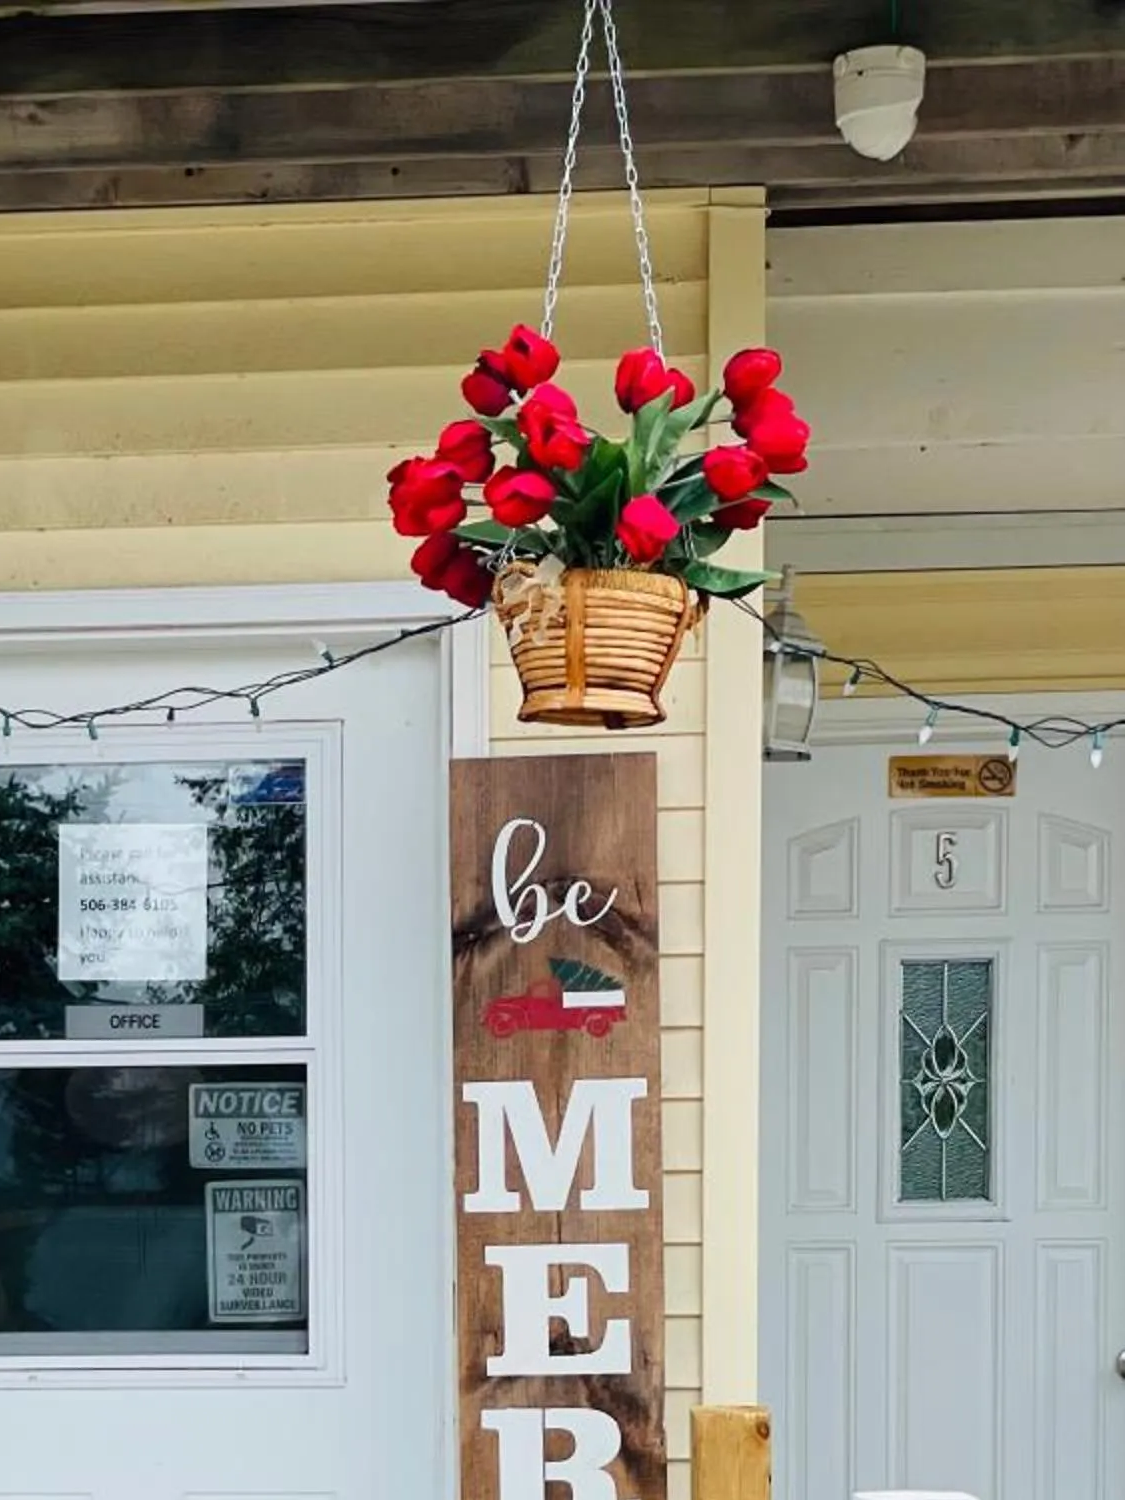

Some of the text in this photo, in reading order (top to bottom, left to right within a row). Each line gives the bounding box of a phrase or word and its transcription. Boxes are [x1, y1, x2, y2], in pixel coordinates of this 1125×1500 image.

[934, 831, 958, 889] 5
[491, 817, 618, 945] be
[109, 1014, 162, 1029] OFFICE
[197, 1090, 300, 1115] NOTICE
[237, 1121, 294, 1135] NO PETS
[215, 1188, 297, 1211] WARNING
[227, 1272, 287, 1286] 24 HOUR
[242, 1287, 274, 1298] VIDEO
[220, 1299, 296, 1311] SURVEILLANCE
